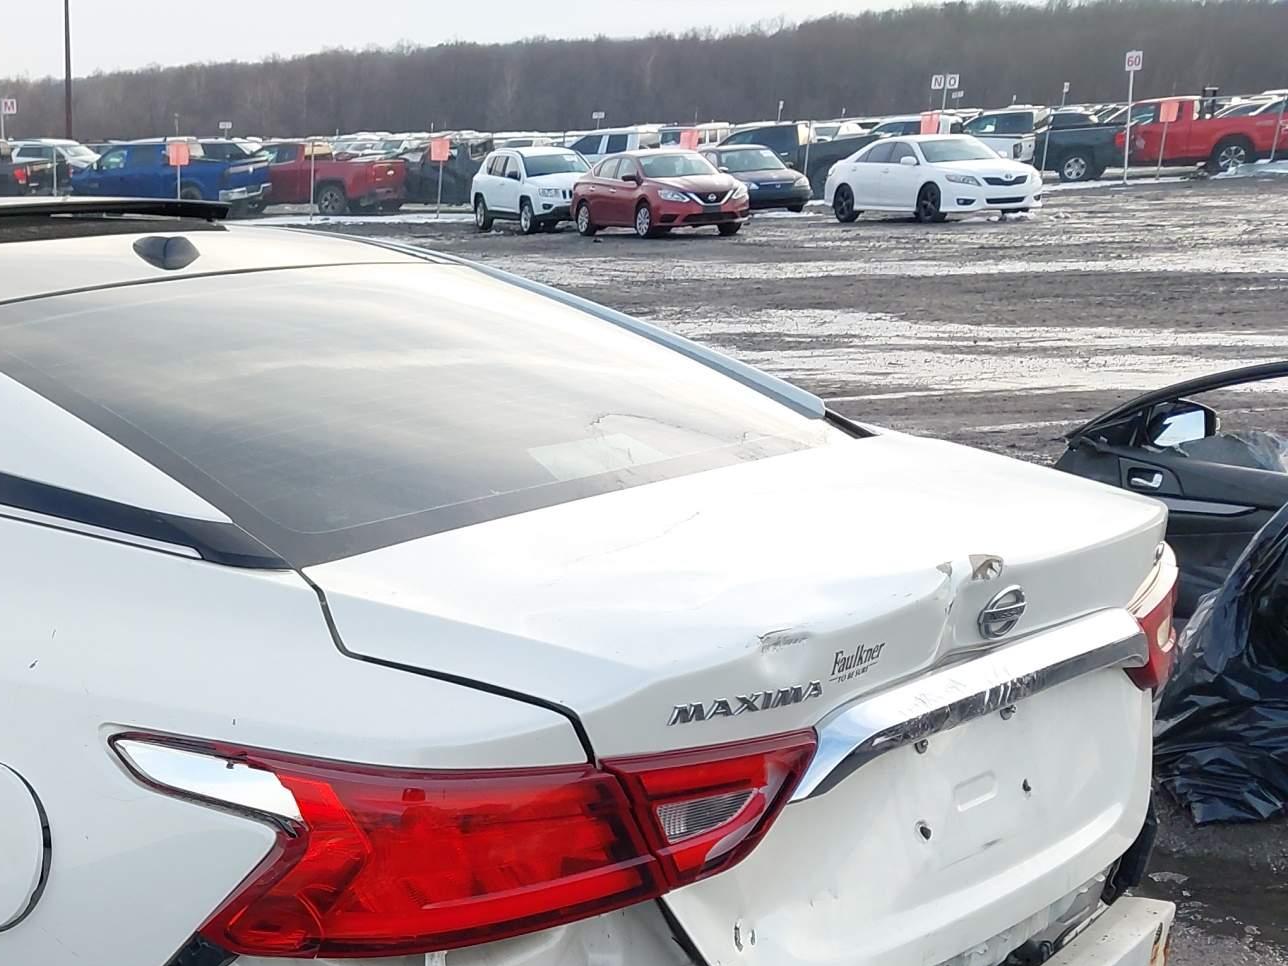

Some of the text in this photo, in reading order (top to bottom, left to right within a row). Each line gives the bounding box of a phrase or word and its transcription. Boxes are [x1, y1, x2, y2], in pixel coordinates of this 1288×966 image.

[1127, 55, 1141, 67] 60
[933, 76, 943, 88] N
[3, 100, 15, 113] M
[830, 641, 886, 677] Faulkner
[666, 679, 823, 727] MAXIMA
